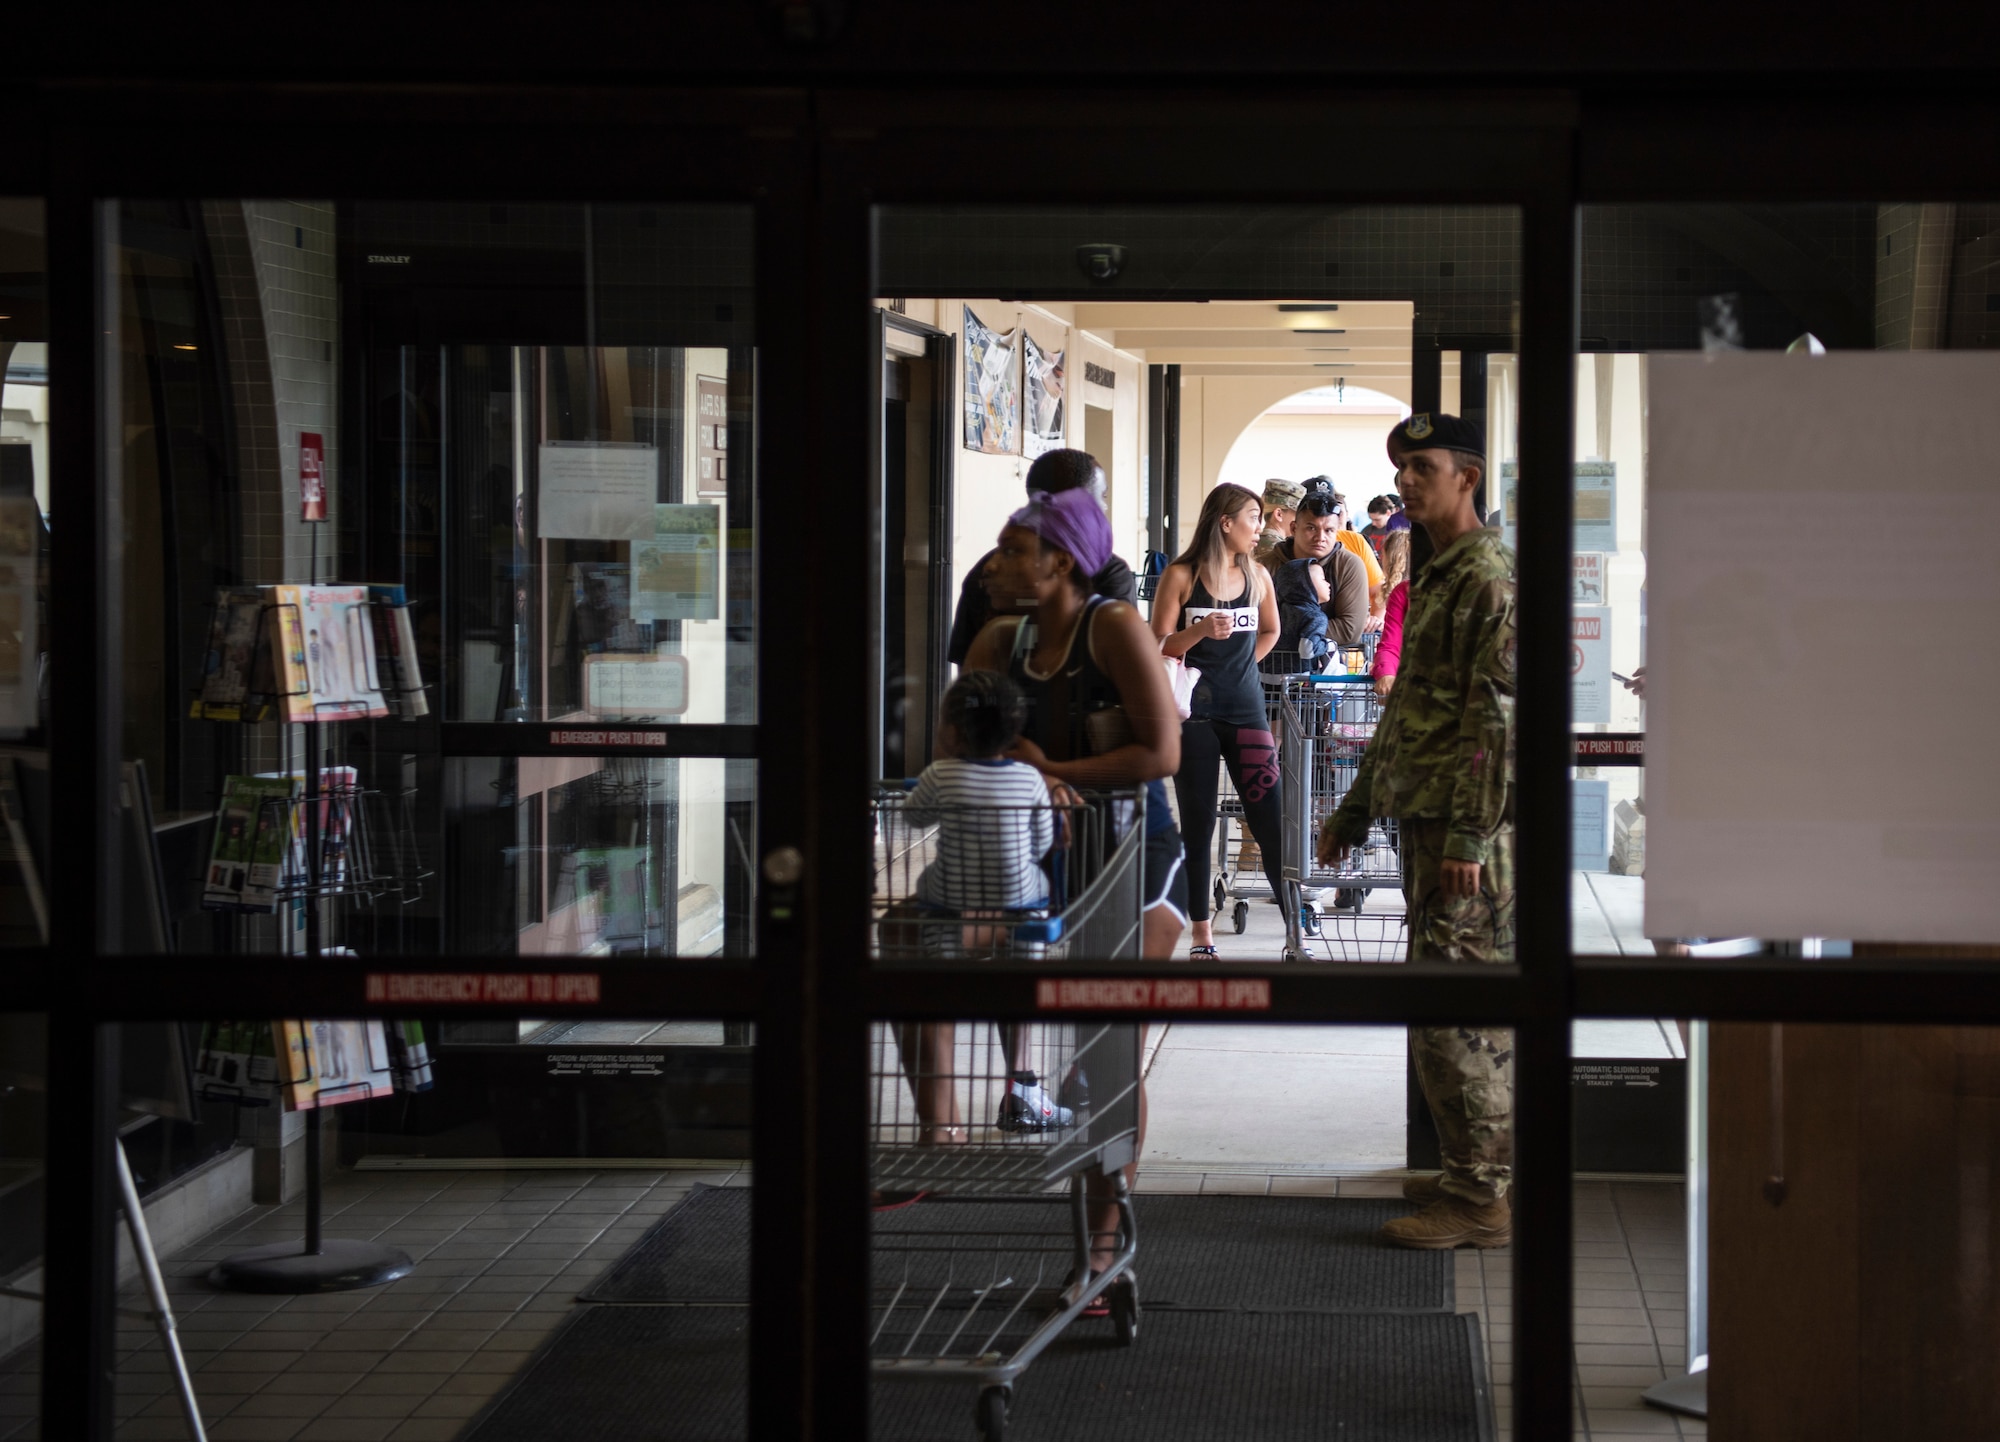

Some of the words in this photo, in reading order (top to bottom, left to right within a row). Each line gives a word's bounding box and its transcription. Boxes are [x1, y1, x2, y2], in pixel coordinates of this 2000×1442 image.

[367, 255, 411, 264] STANLEY
[550, 731, 560, 744] IN
[560, 731, 608, 745] EMERGENCY
[609, 732, 631, 745] PUSH
[632, 732, 644, 745] TO
[644, 732, 667, 746] OPEN
[1589, 741, 1612, 753] PUSH
[1613, 741, 1625, 753] TO
[387, 974, 483, 1002] EMERGENCY
[483, 974, 528, 1002] PUSH
[530, 974, 552, 1002] TO
[554, 974, 599, 1002] OPEN
[1058, 980, 1154, 1007] EMERGENCY
[1155, 980, 1199, 1007] PUSH
[1201, 980, 1223, 1007] TO
[1225, 980, 1270, 1008] OPEN
[579, 1054, 618, 1062] AUTOMATIC
[619, 1054, 645, 1062] SLIDING
[645, 1054, 664, 1062] DOOR
[1573, 1065, 1613, 1073] AUTOMATIC
[1613, 1065, 1640, 1073] SLIDING
[1640, 1065, 1660, 1073] DOOR
[1624, 1073, 1651, 1081] warning
